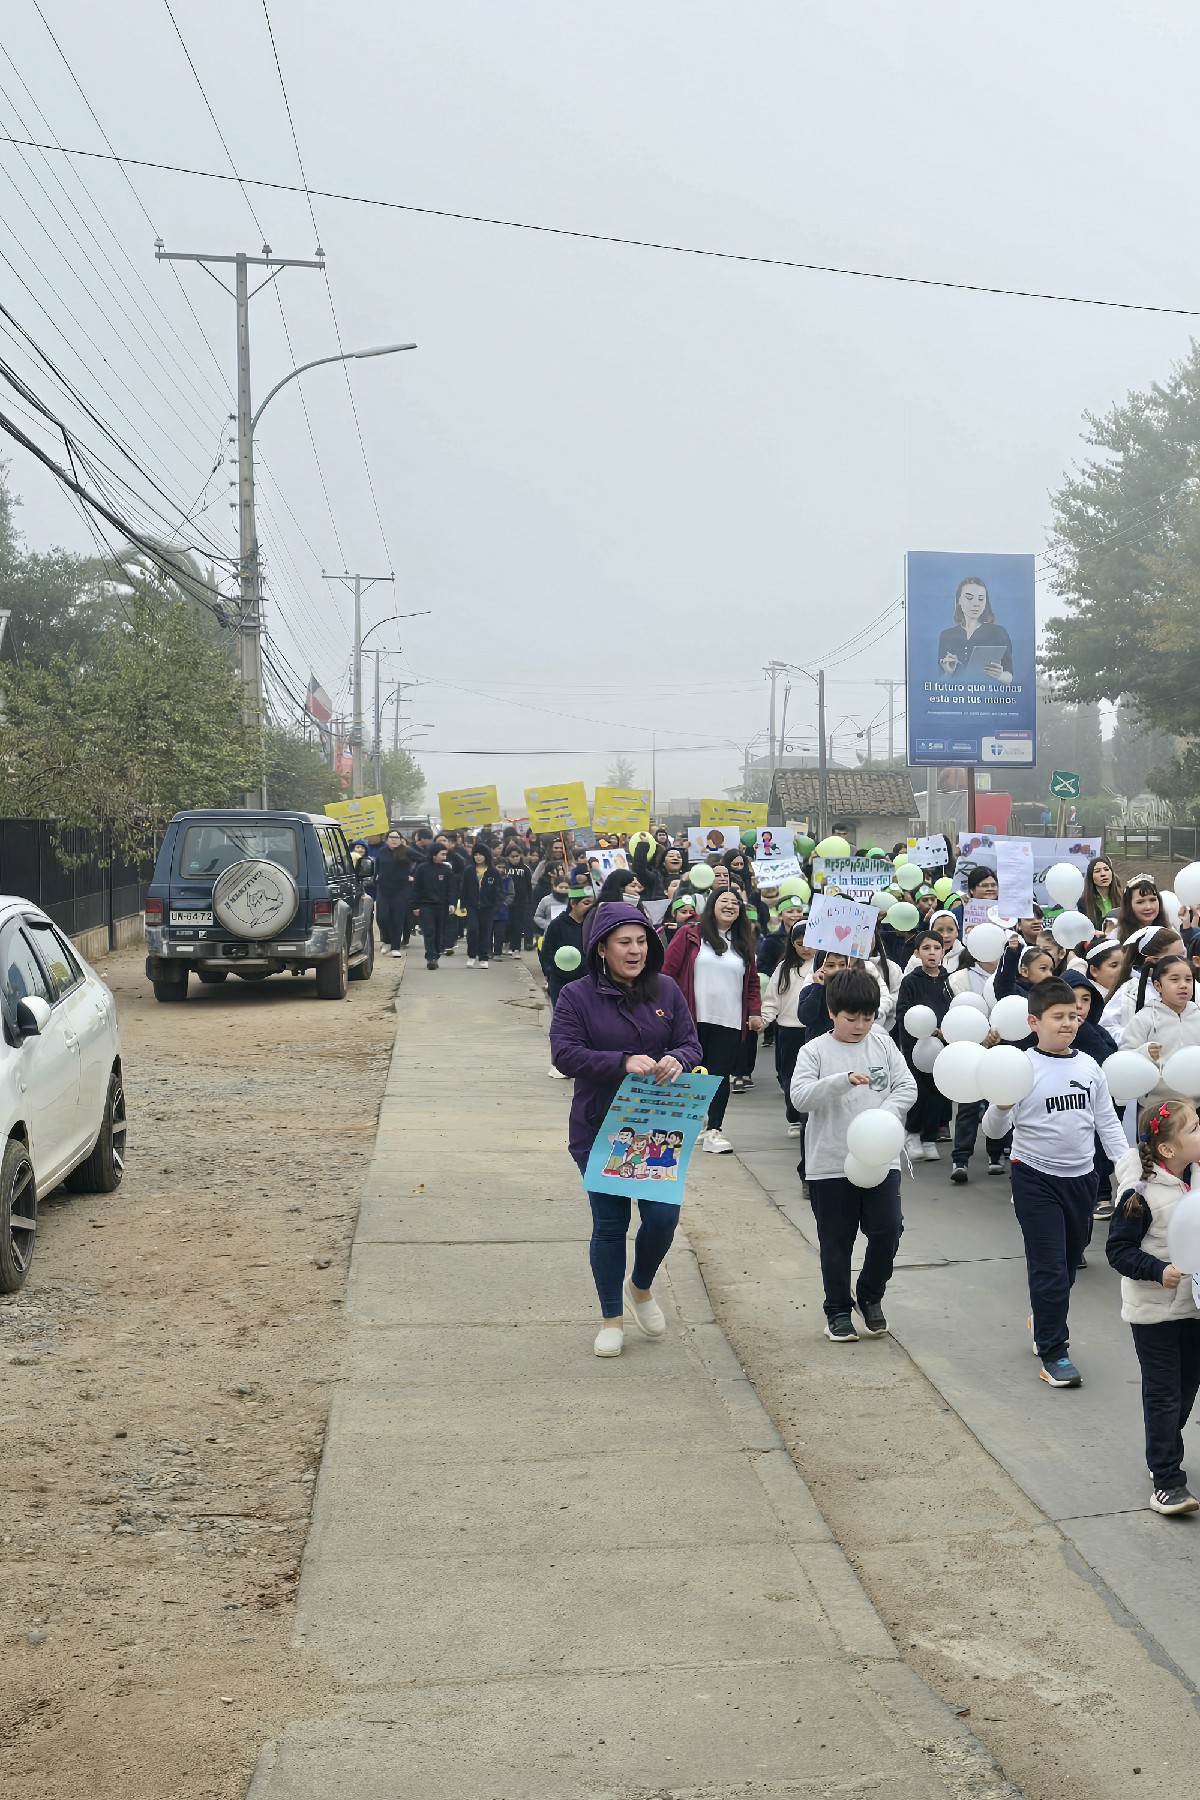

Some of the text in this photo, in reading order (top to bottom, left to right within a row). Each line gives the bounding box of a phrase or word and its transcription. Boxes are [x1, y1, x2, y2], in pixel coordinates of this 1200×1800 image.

[924, 681, 932, 691] El
[935, 681, 965, 692] futuro
[967, 684, 986, 694] que
[952, 696, 965, 704] en
[967, 695, 982, 704] tus
[984, 696, 1017, 705] manos
[1045, 1093, 1086, 1114] PUMA
